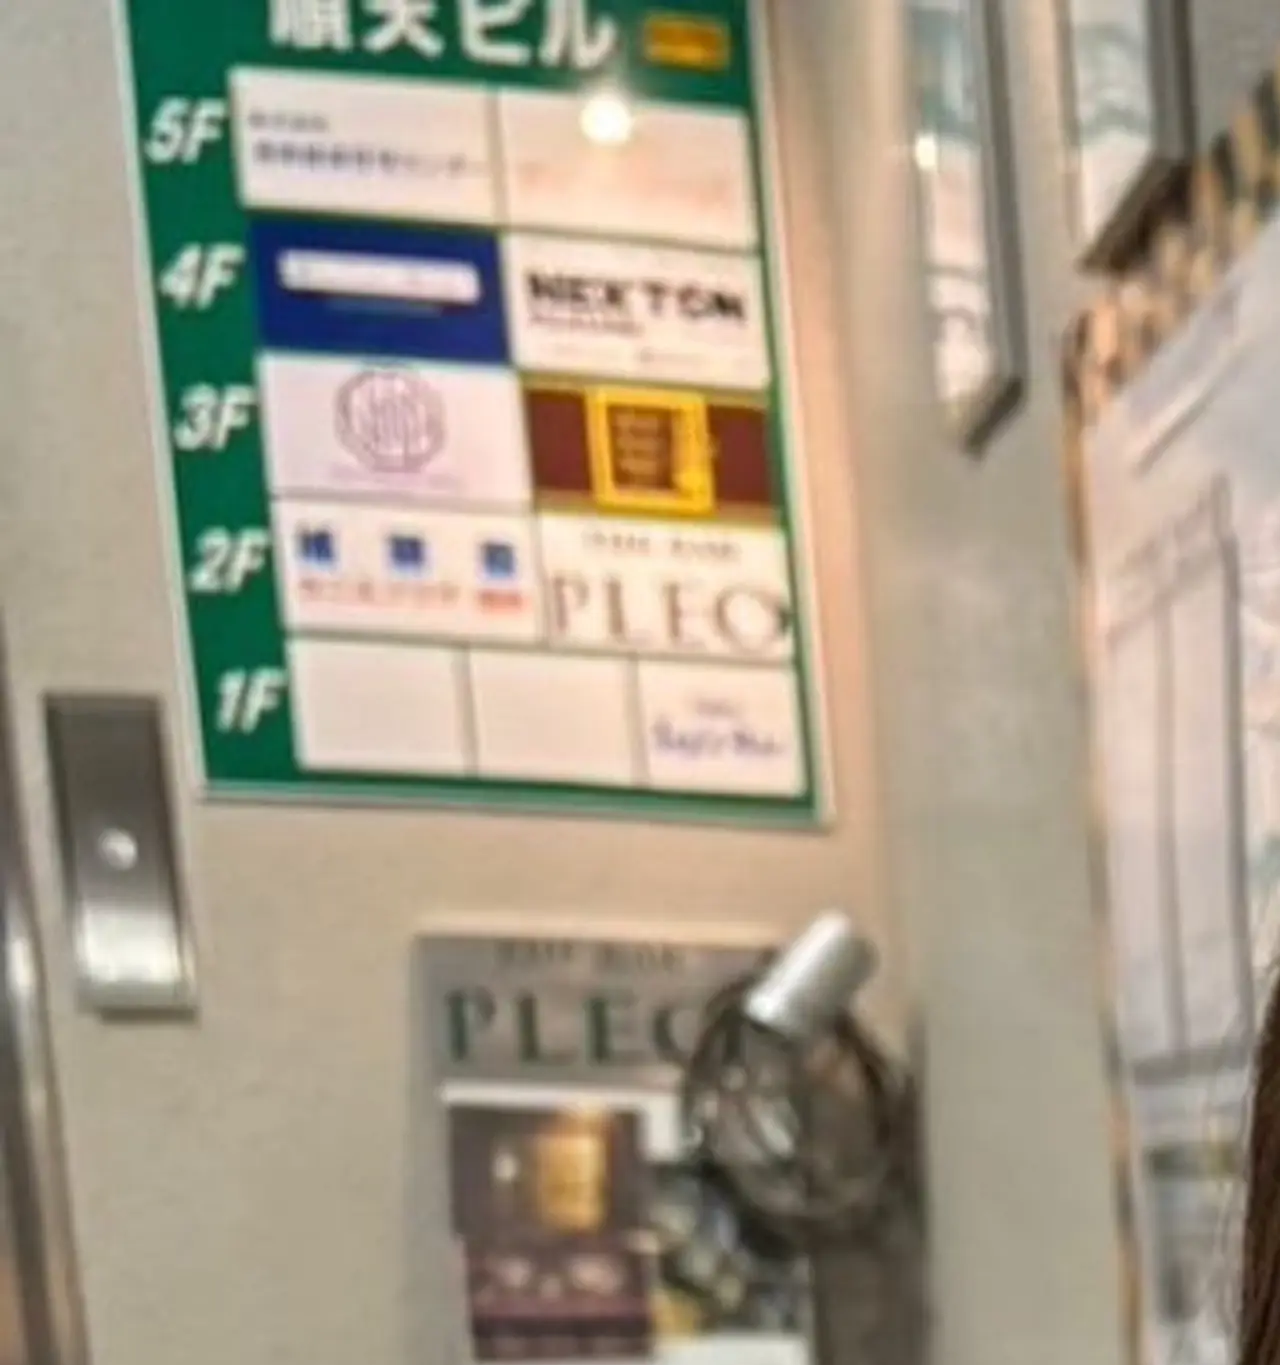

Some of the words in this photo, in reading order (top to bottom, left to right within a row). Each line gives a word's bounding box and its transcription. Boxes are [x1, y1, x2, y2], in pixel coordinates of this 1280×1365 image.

[146, 98, 227, 165] 5F
[161, 245, 244, 309] 4F
[174, 383, 255, 449] 3F
[190, 527, 269, 592] 2F
[214, 669, 287, 731] 1F
